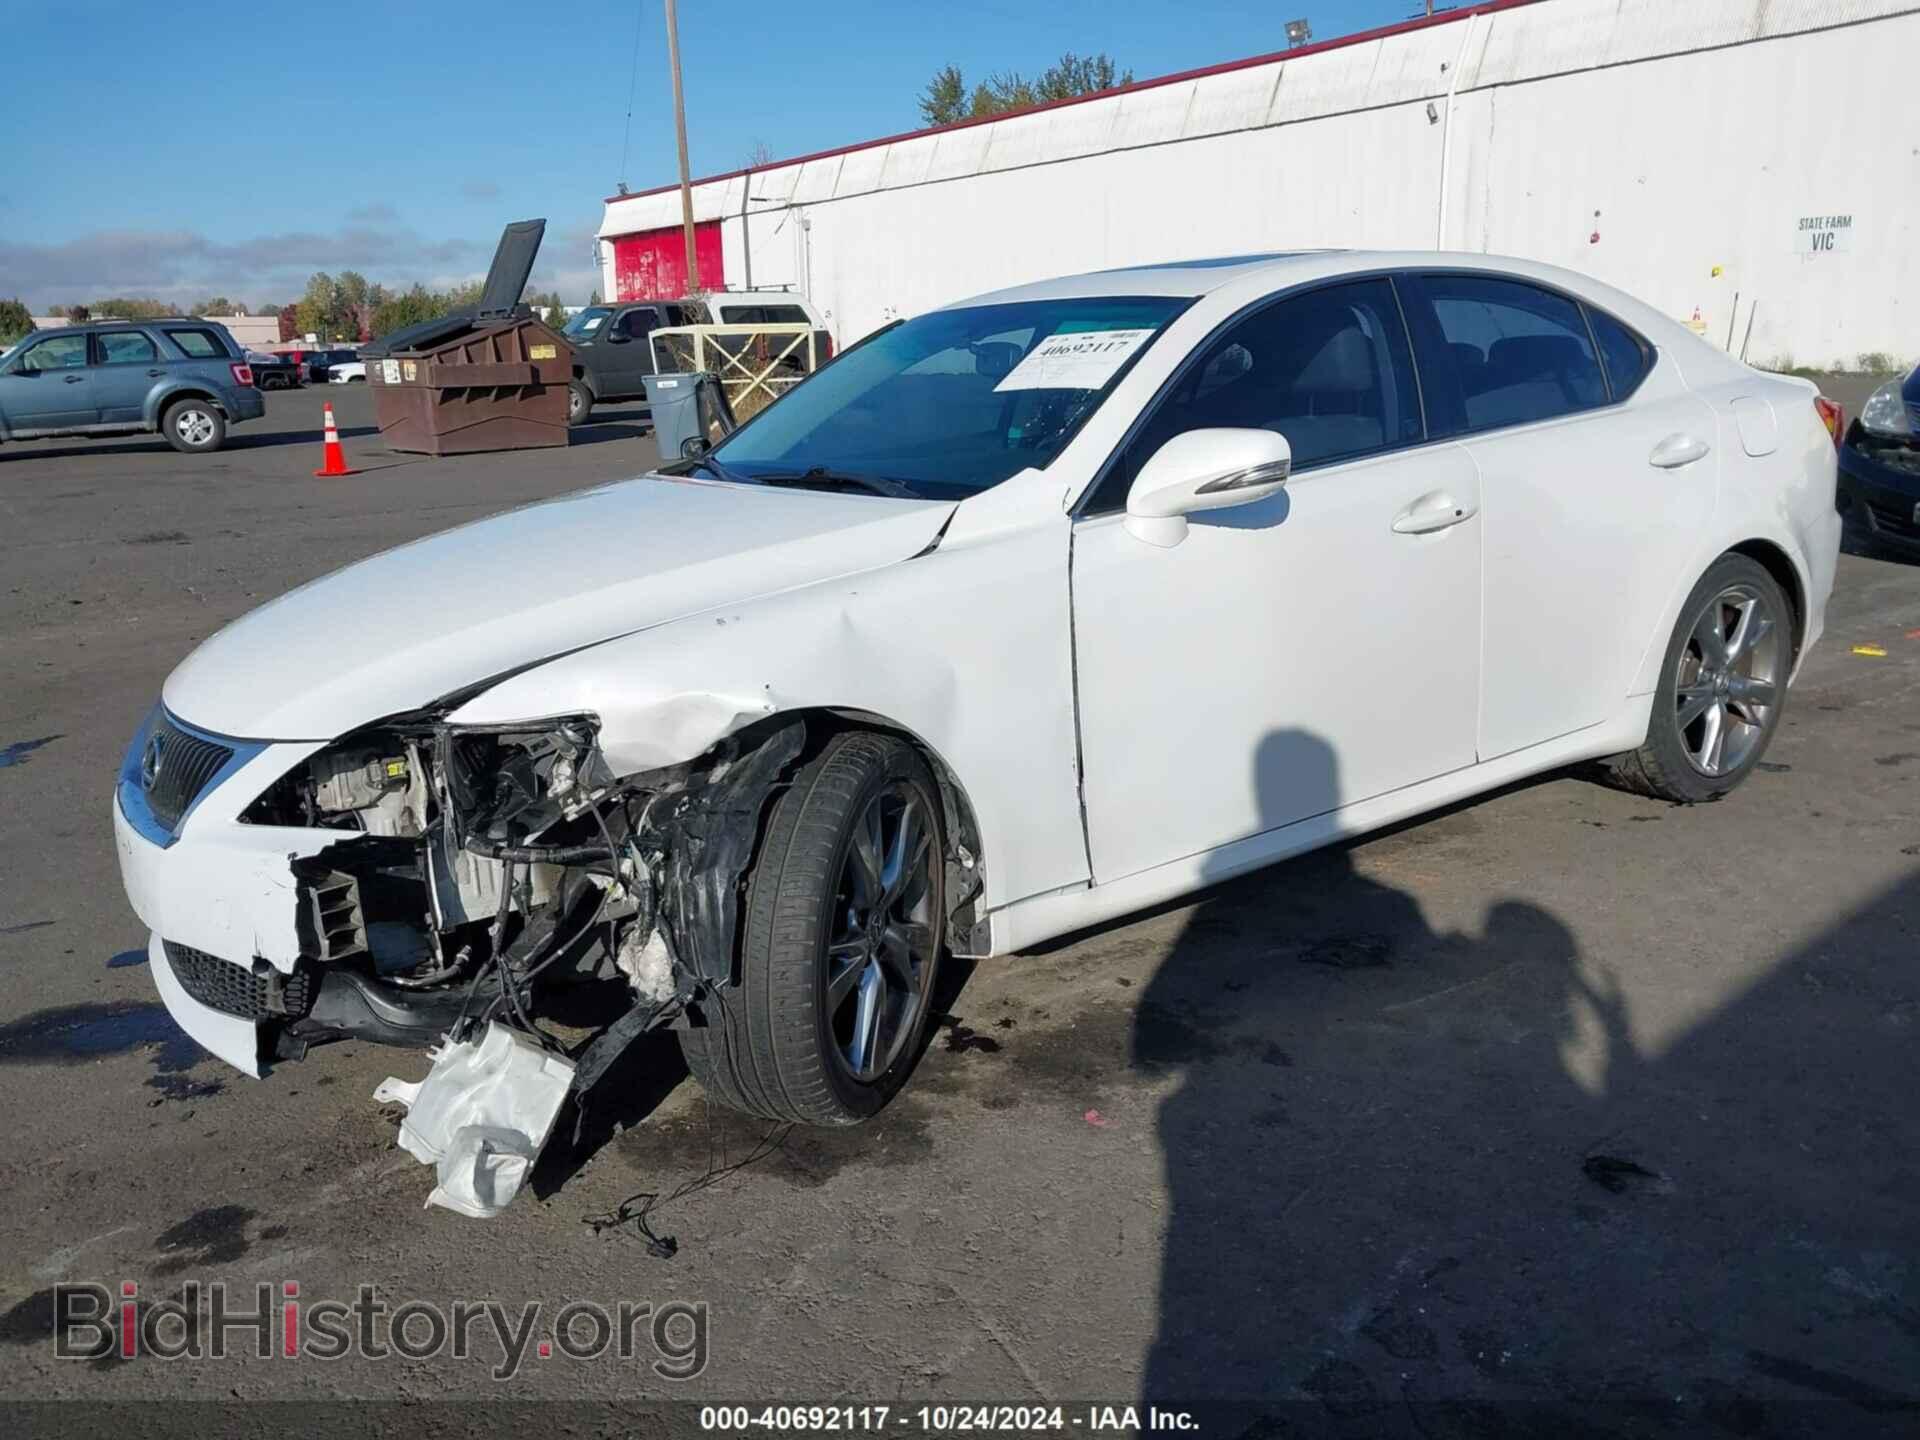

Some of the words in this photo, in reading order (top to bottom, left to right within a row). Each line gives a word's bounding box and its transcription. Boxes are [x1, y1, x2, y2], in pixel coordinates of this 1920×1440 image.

[1799, 215, 1823, 231] STATE
[1825, 215, 1853, 229] FARM
[1812, 232, 1835, 250] VIC
[1041, 341, 1129, 356] 40692117
